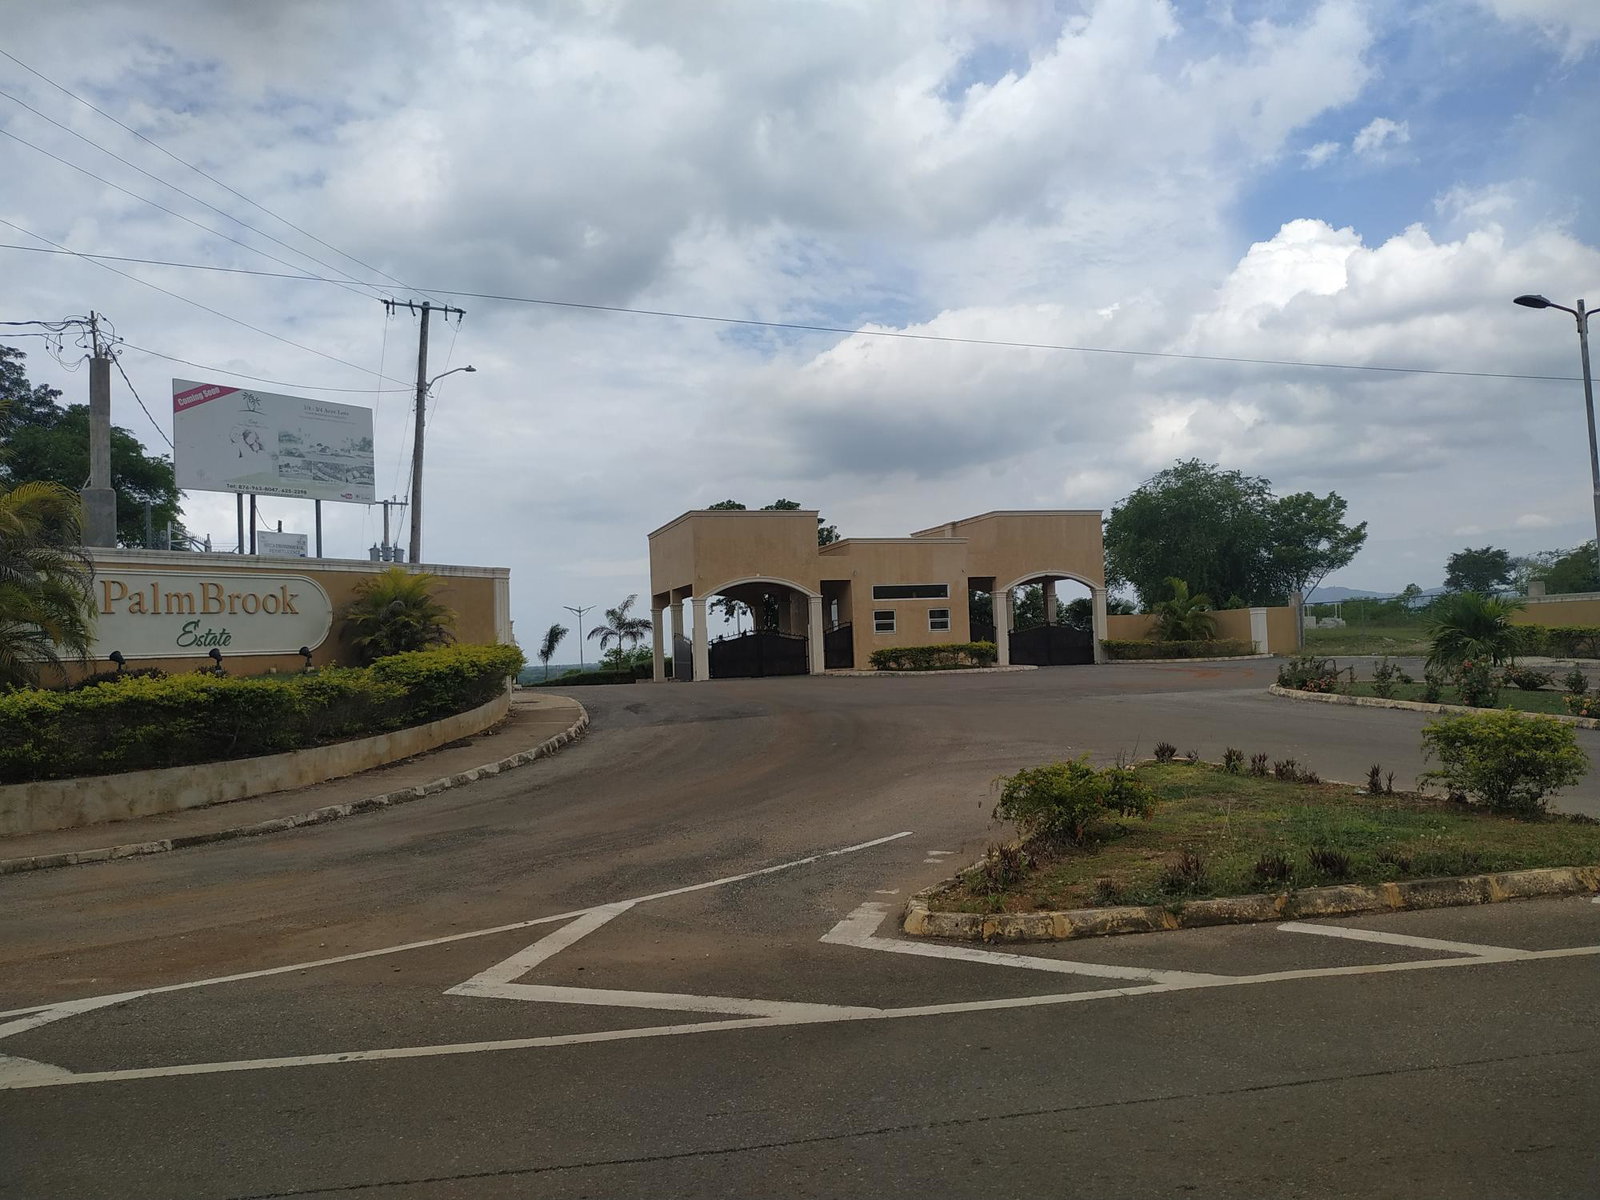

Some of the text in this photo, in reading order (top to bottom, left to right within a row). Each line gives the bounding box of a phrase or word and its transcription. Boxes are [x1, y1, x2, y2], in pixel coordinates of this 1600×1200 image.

[177, 386, 221, 406] Coming Soon
[100, 580, 299, 615] PalmBrook
[176, 619, 232, 648] Estate
